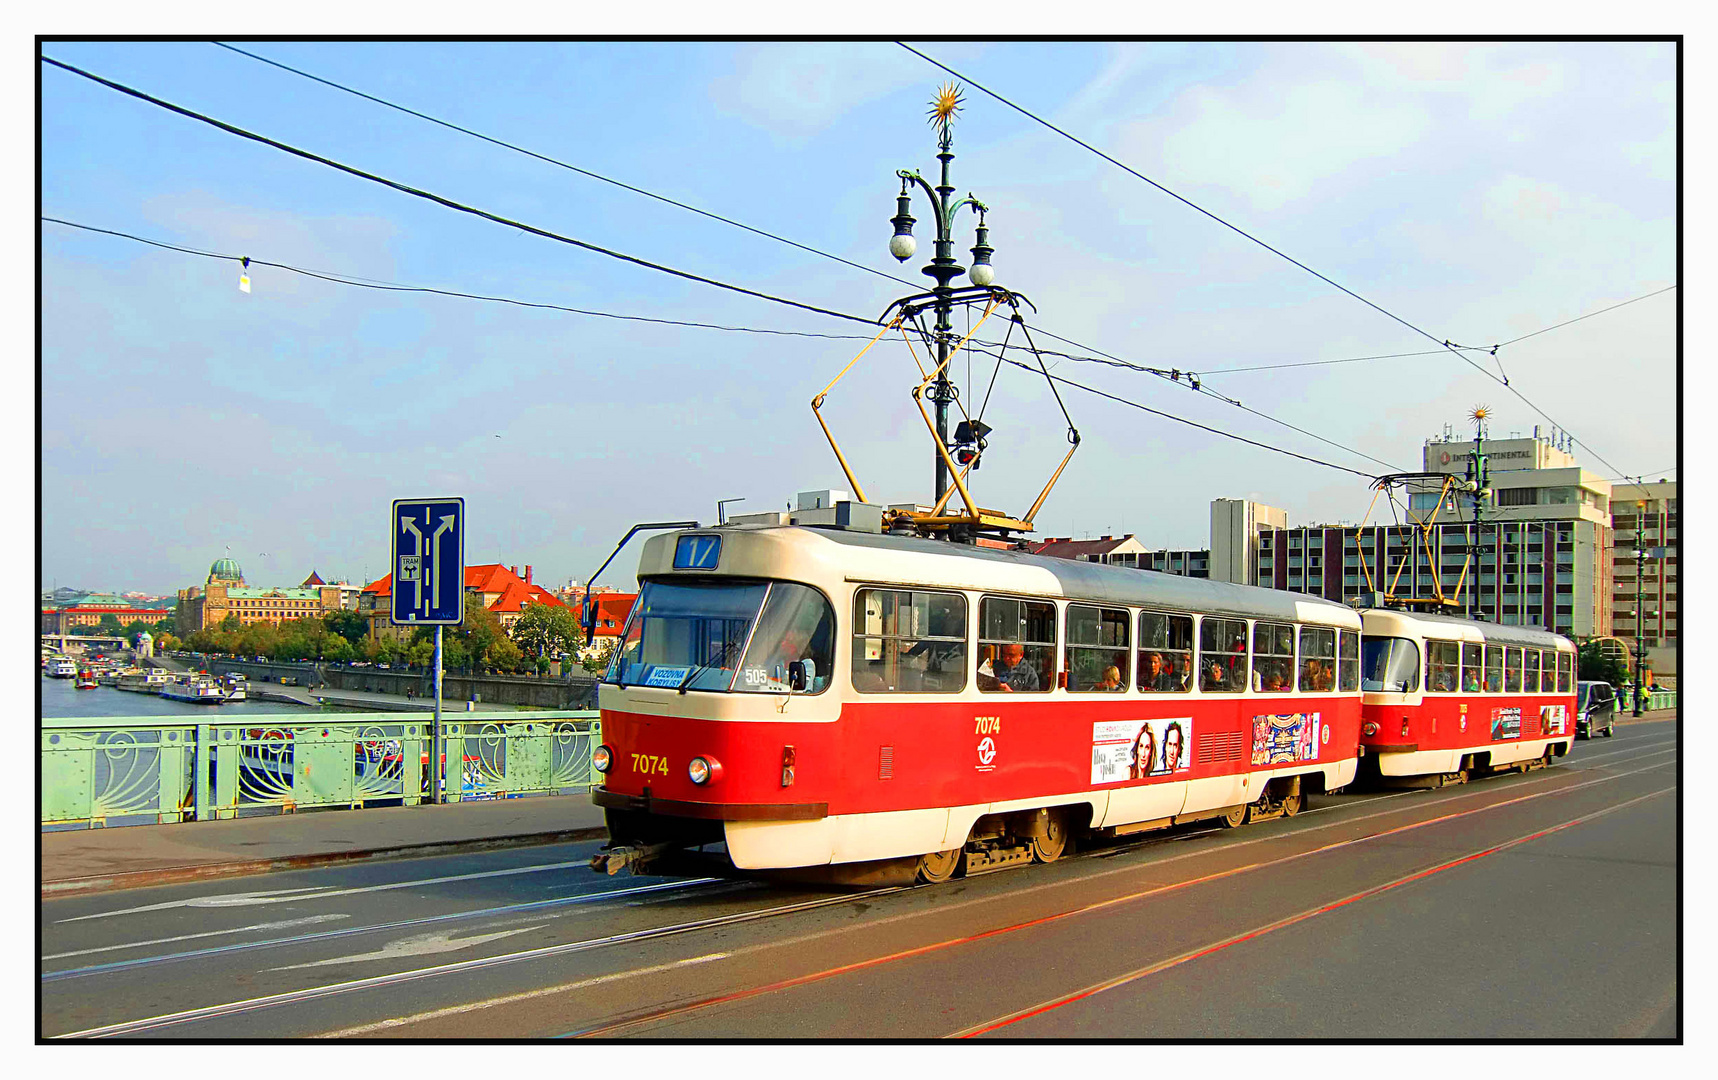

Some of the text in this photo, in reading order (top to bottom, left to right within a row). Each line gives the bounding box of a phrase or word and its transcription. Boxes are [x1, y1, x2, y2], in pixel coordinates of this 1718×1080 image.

[1452, 451, 1532, 462] INTENTINENTAL
[688, 537, 717, 567] 17
[653, 668, 685, 678] VOZOVNA
[745, 668, 767, 684] 505
[974, 716, 1001, 735] 7074
[631, 753, 669, 776] 7074
